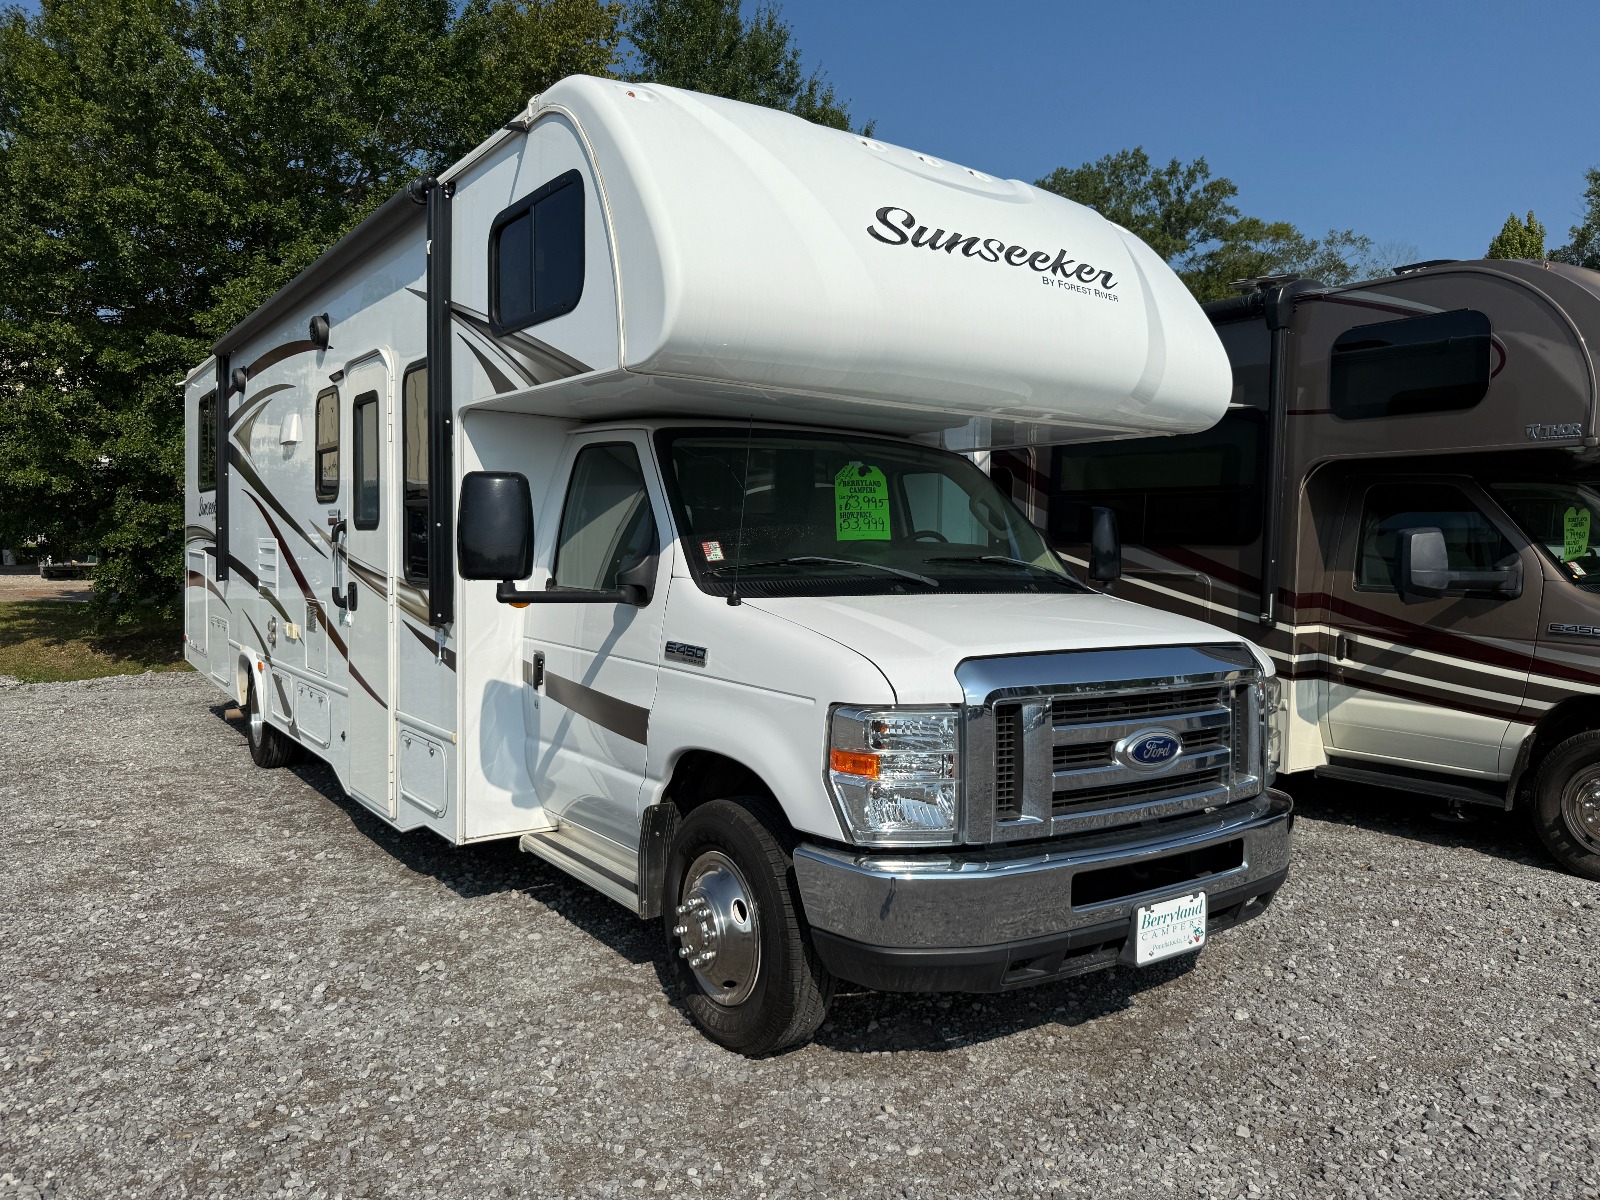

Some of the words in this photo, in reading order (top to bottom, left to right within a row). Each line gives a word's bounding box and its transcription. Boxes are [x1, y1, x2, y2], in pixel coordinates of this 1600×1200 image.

[866, 206, 1119, 290] Sunseeker
[1042, 275, 1055, 288] BY
[1057, 279, 1093, 297] FOREST
[1093, 288, 1119, 303] RIVER
[1541, 423, 1582, 437] THOR
[1143, 739, 1171, 759] Ford
[1141, 899, 1204, 930] Berryland
[1141, 919, 1203, 941] CAMPERS
